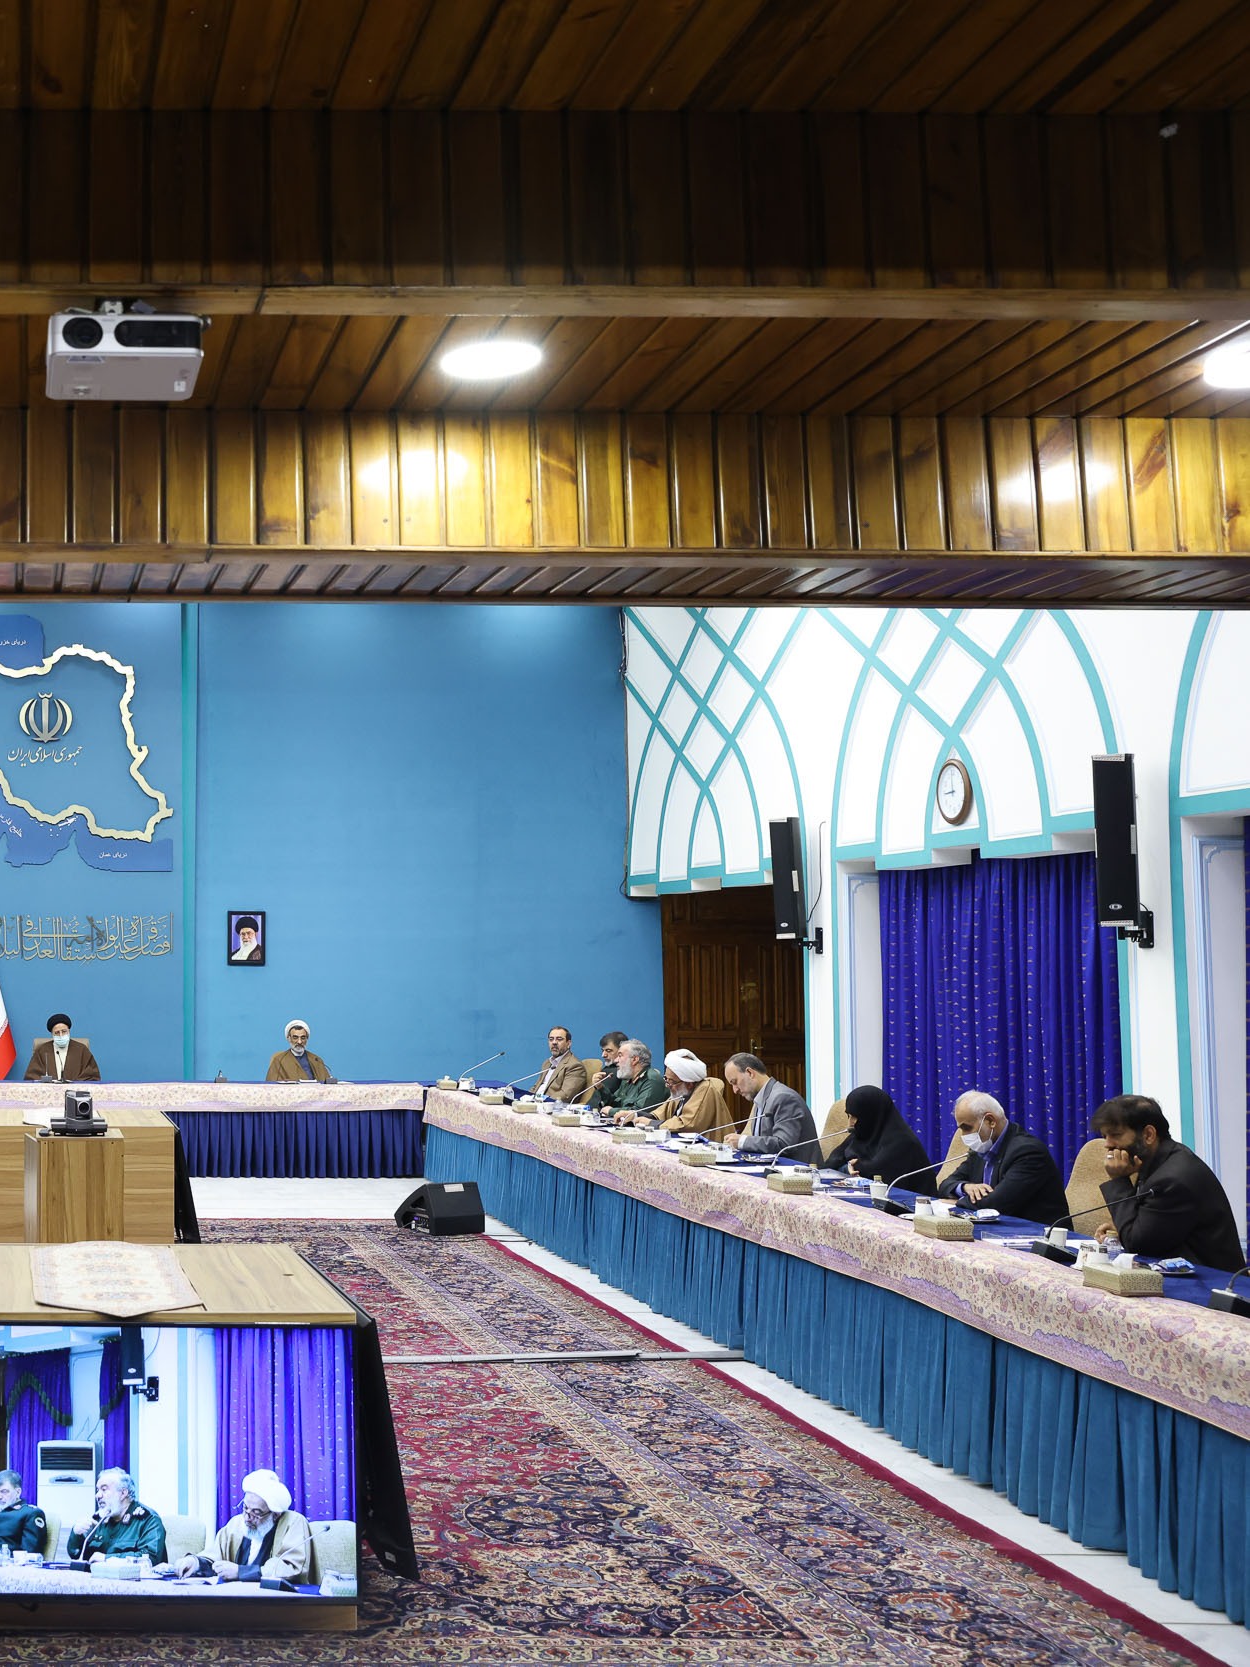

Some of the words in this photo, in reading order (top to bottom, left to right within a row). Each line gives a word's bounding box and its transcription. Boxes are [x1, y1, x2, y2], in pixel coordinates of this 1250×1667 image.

[7, 747, 31, 767] ایران
[29, 746, 54, 763] اسلامی
[53, 745, 83, 767] جمهوری
